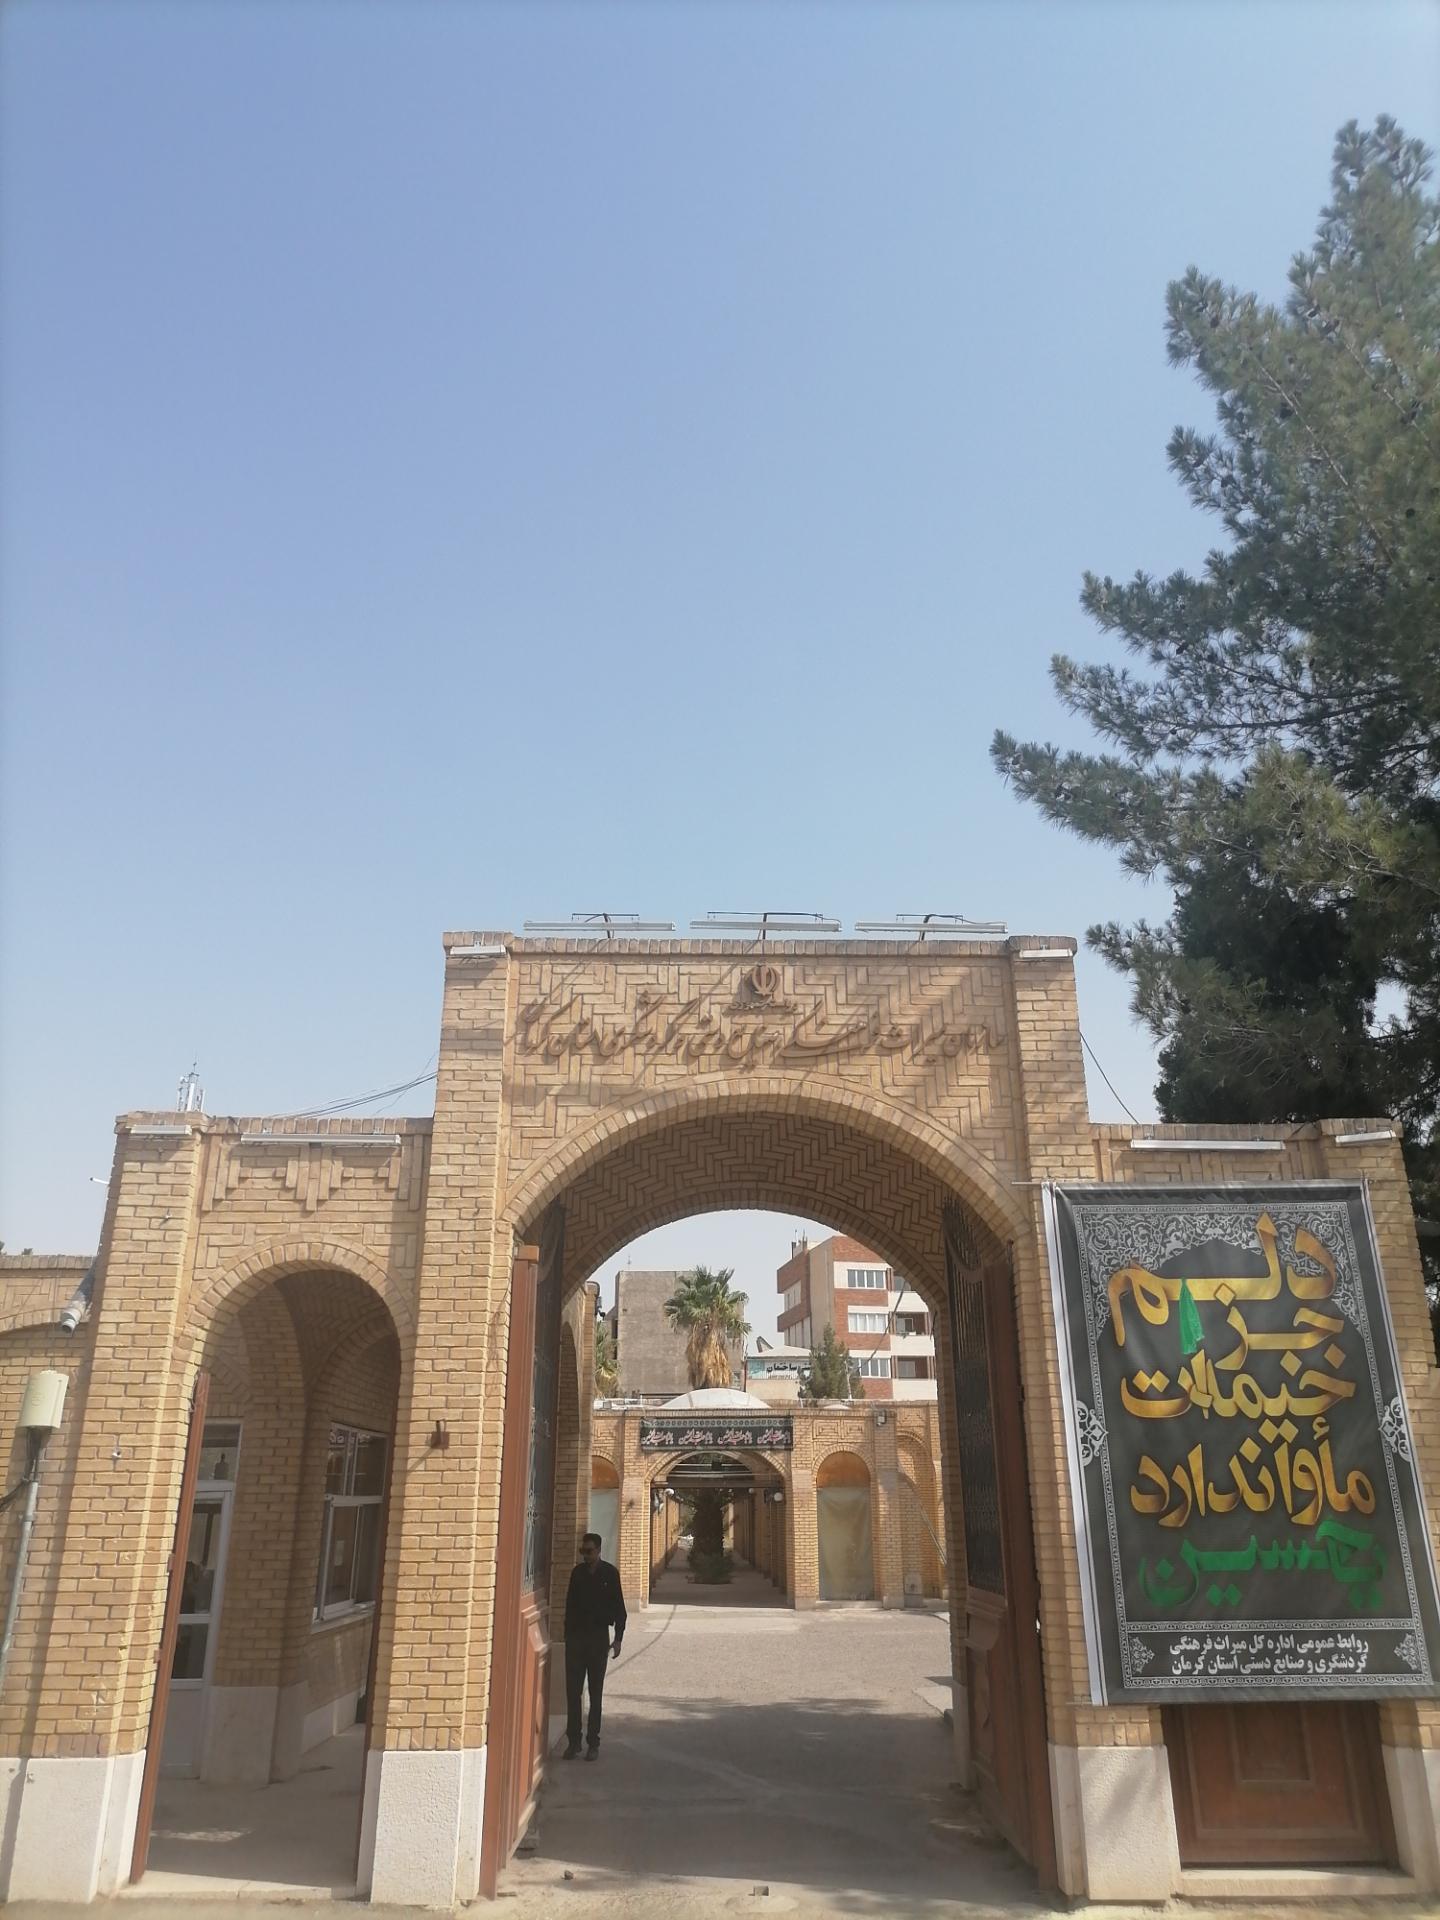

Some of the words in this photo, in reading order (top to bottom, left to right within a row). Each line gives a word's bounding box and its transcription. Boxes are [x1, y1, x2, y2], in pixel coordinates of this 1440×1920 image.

[1107, 1211, 1337, 1347] دلم
[1214, 1283, 1347, 1371] جز
[1130, 1437, 1275, 1528] ندارد
[1169, 1634, 1212, 1655] فرهنگی
[1214, 1635, 1247, 1655] میراث
[1248, 1634, 1265, 1654] کل
[1267, 1634, 1295, 1654] اداره
[1297, 1637, 1335, 1653] عمومی
[1336, 1633, 1369, 1654] روابط
[1171, 1653, 1205, 1675] کرمان
[1207, 1655, 1238, 1674] استان
[1240, 1657, 1271, 1674] دستی
[1273, 1654, 1305, 1674] صنایع
[1306, 1661, 1314, 1673] و
[1315, 1653, 1368, 1673] گردشگری
